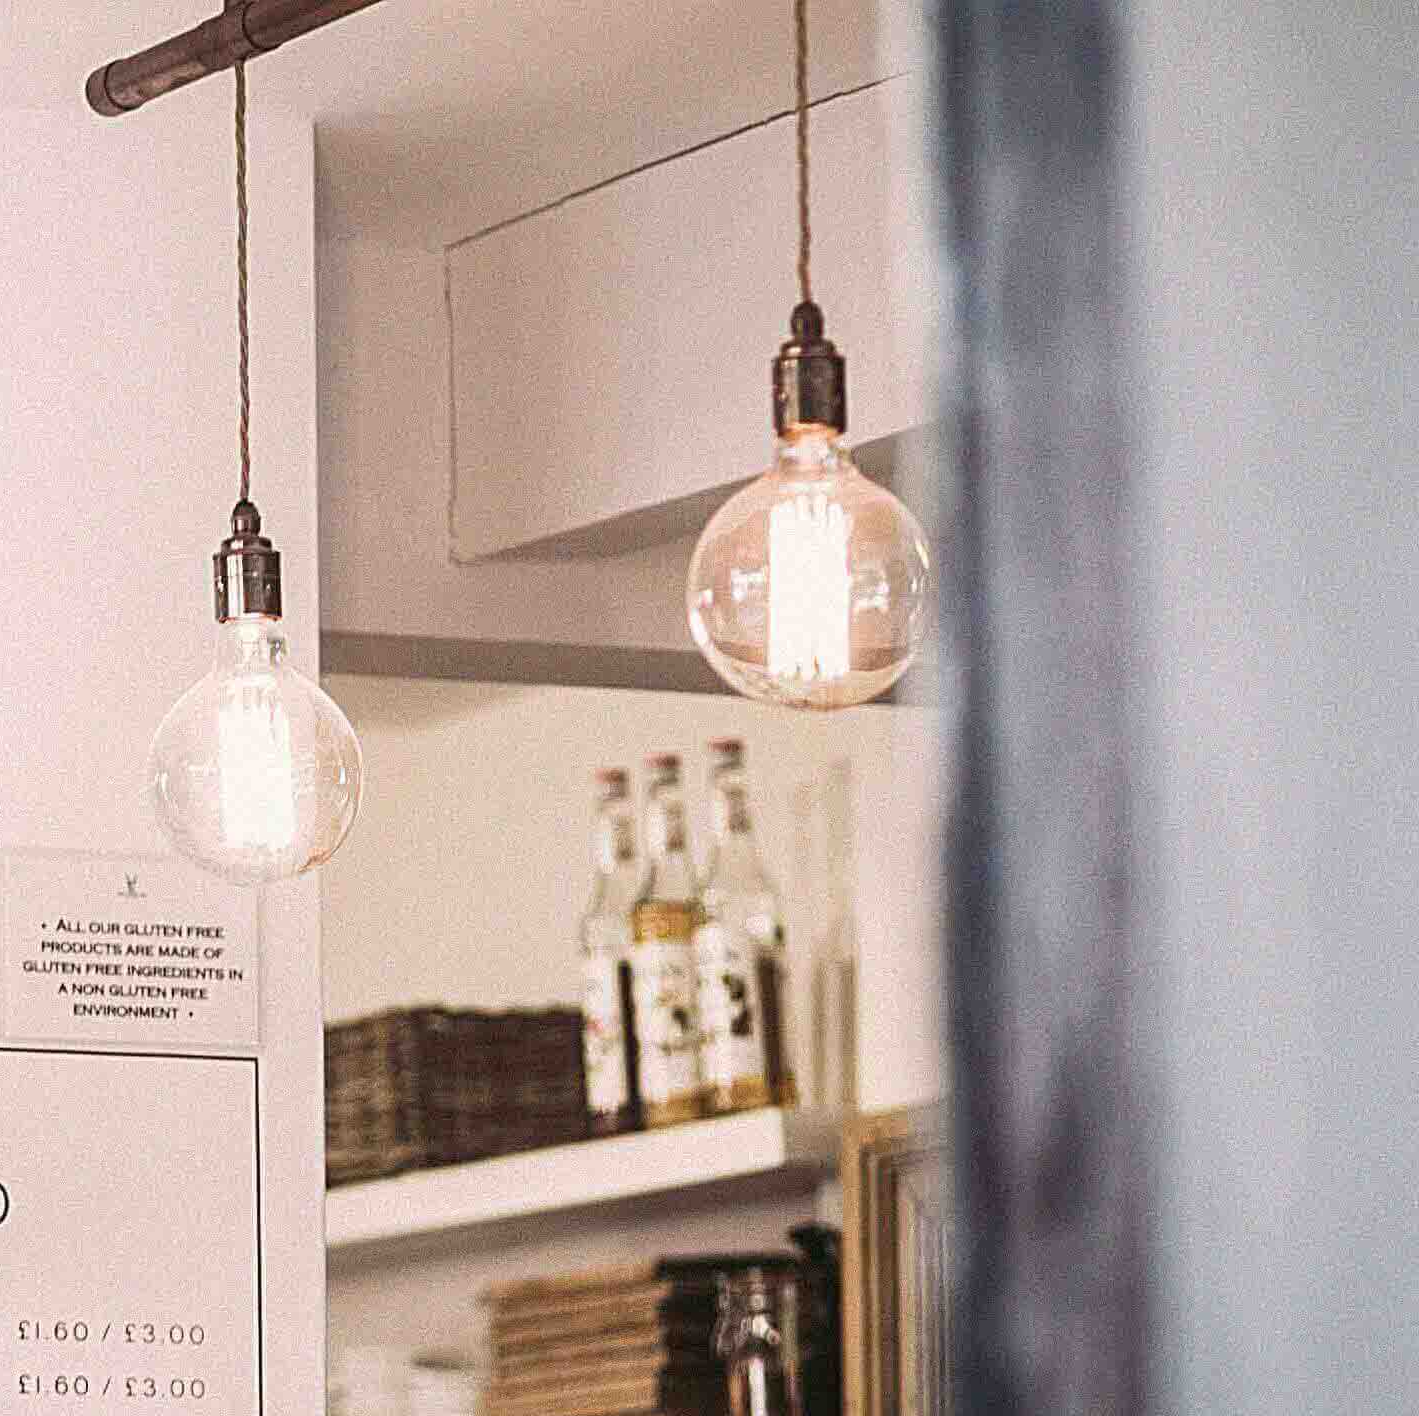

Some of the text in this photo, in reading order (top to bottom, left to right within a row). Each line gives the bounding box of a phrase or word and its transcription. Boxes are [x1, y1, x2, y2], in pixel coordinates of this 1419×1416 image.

[56, 920, 225, 939] ALL OUR GLUTEN FREE
[41, 941, 224, 960] PRODUCTS ARE MADE OF
[24, 961, 243, 981] GLUTEN FREE INGREDIENTS IN
[59, 982, 208, 1000] A NON GLUTEN FREE
[74, 1003, 179, 1019] ENVIRONMENT
[17, 1319, 89, 1343] £1.60
[124, 1322, 206, 1346] £3.00
[18, 1373, 90, 1397] £1.60
[124, 1376, 206, 1400] £3.00
